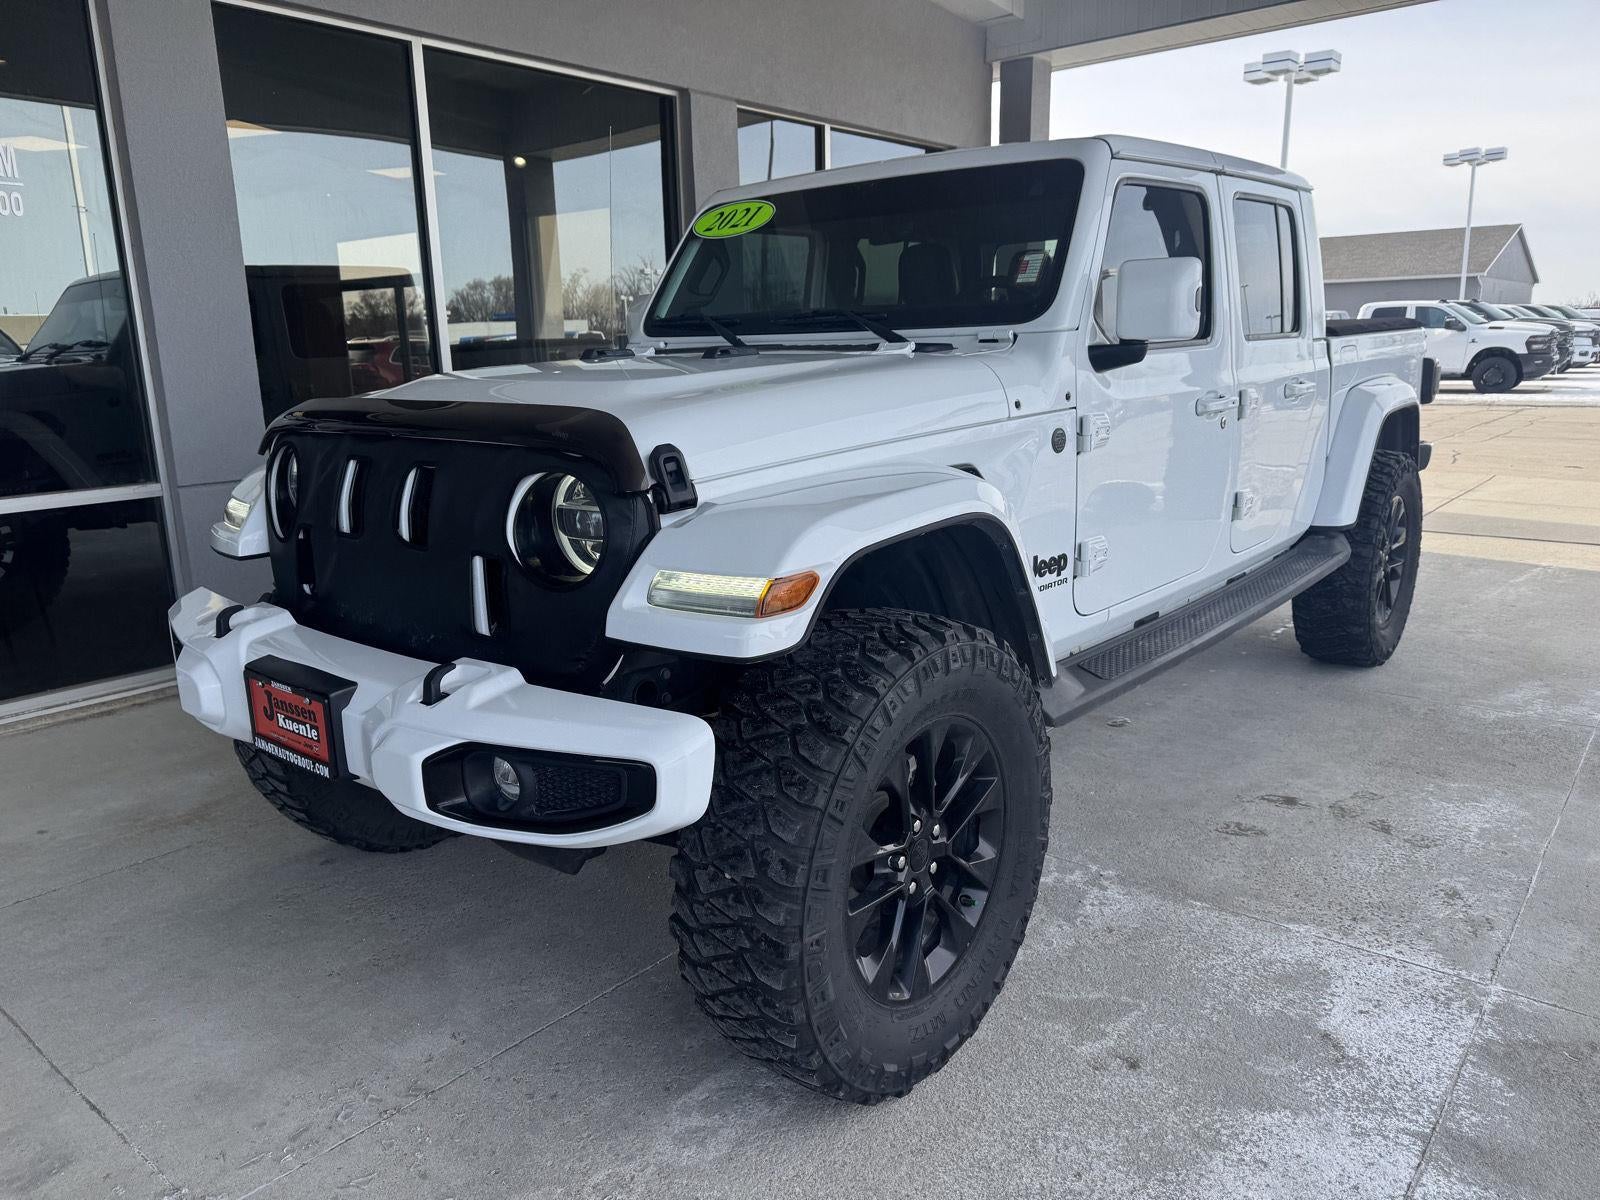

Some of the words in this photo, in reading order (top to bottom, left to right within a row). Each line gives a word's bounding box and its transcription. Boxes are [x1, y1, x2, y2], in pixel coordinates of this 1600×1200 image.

[703, 205, 764, 233] 2021
[1038, 577, 1068, 592] DIATOR
[263, 689, 318, 723] Janssen
[276, 713, 318, 740] Kuenle
